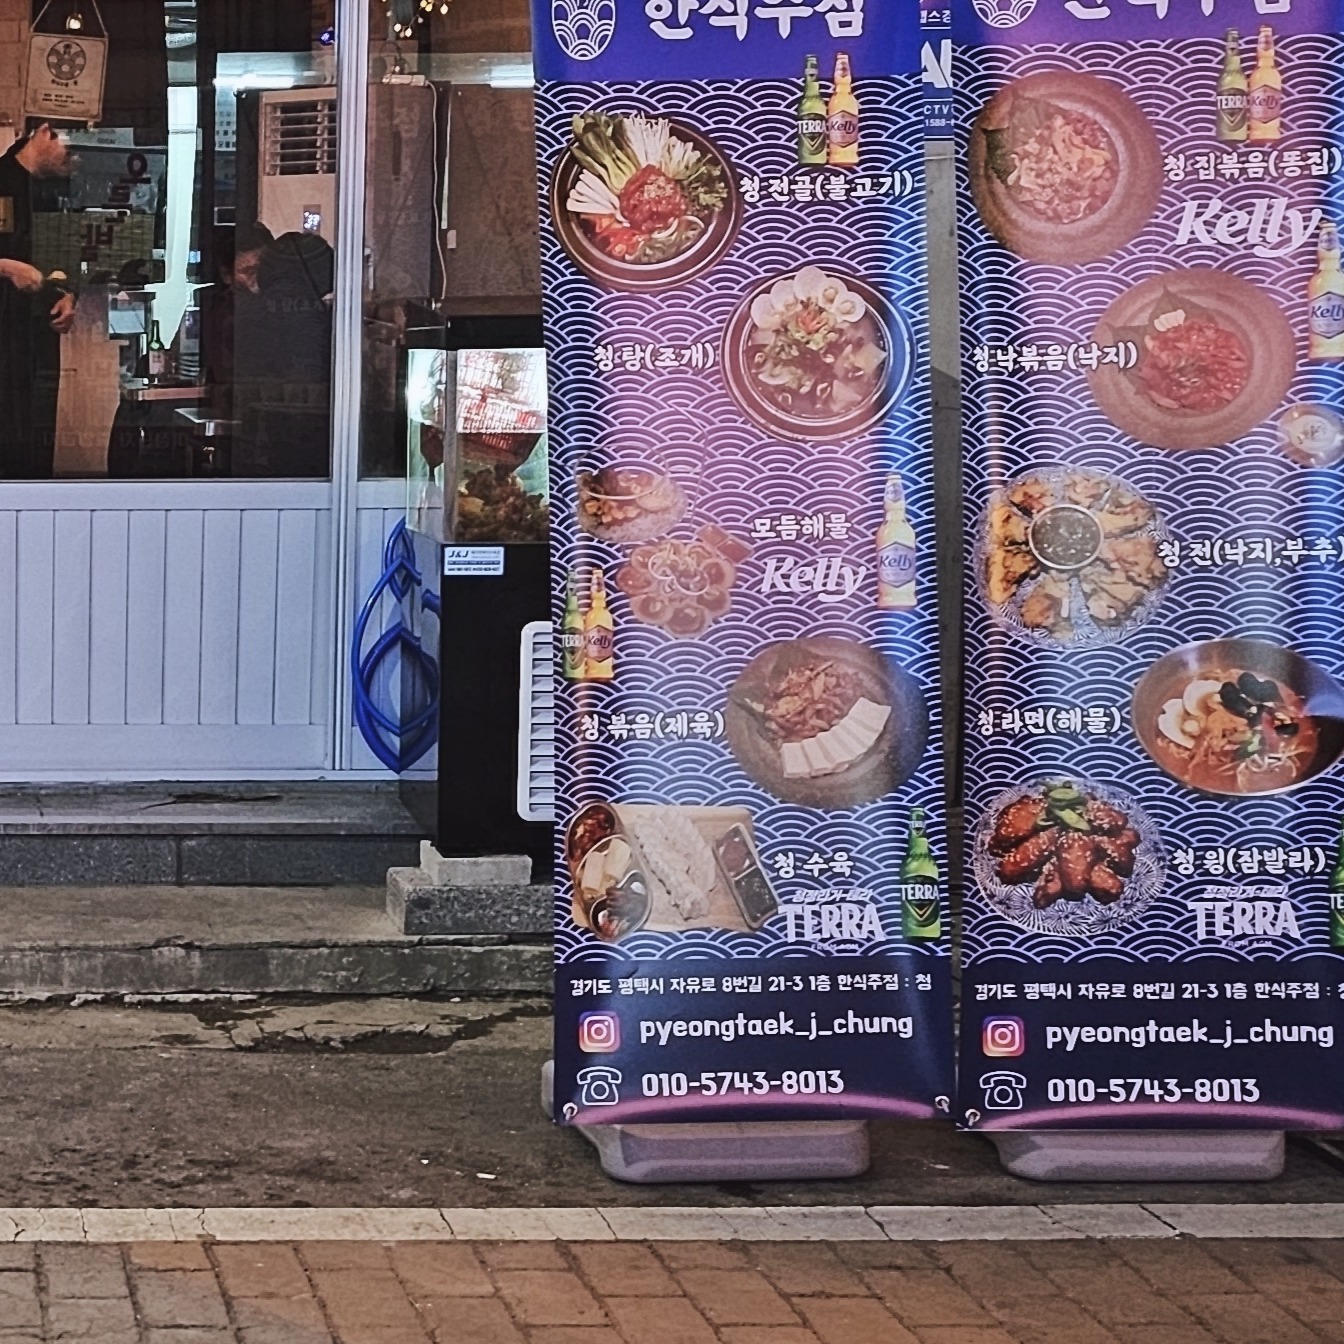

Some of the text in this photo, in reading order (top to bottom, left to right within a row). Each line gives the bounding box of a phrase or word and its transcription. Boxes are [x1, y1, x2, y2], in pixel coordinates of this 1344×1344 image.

[1163, 153, 1185, 181] 청
[739, 170, 913, 202] 청 전골(불고기)
[1175, 196, 1323, 258] Kelly
[593, 342, 715, 371] 청 탕(조개)
[973, 342, 1138, 372] 청 낙볶음(낙지)
[751, 513, 852, 541] 모듬해물
[879, 555, 913, 571] Kelly
[1158, 539, 1180, 567] 청
[761, 556, 867, 603] Kelly
[580, 711, 724, 740] 청 볶음(제육)
[978, 707, 1121, 736] 청 라면(해물)
[774, 852, 854, 878] 청 수육
[1172, 847, 1195, 875] 청
[901, 884, 940, 901] TERRA
[778, 903, 886, 943] TERRA
[1187, 901, 1302, 940] TERRA
[570, 979, 612, 996] 경기도
[617, 978, 664, 995] 평택시
[670, 977, 717, 993] 자유로
[722, 976, 762, 993] 8번길
[768, 975, 804, 991] 21-3
[809, 975, 831, 992] 1층
[837, 974, 899, 991] 한식주점
[915, 973, 932, 991] 청
[975, 984, 1018, 1000] 경기도
[1023, 983, 1072, 1000] 평택시
[1077, 983, 1127, 999] 자유로
[1133, 983, 1175, 1000] 8번길
[1181, 983, 1218, 999] 21-3
[1223, 982, 1247, 999] 1층
[640, 1009, 913, 1046] pyeongtaek_j_chung
[1046, 1018, 1334, 1052] pyeongtaek_j_chung
[642, 1069, 844, 1097] 010-5743-8013
[1047, 1077, 1260, 1103] 010-5743-8013
